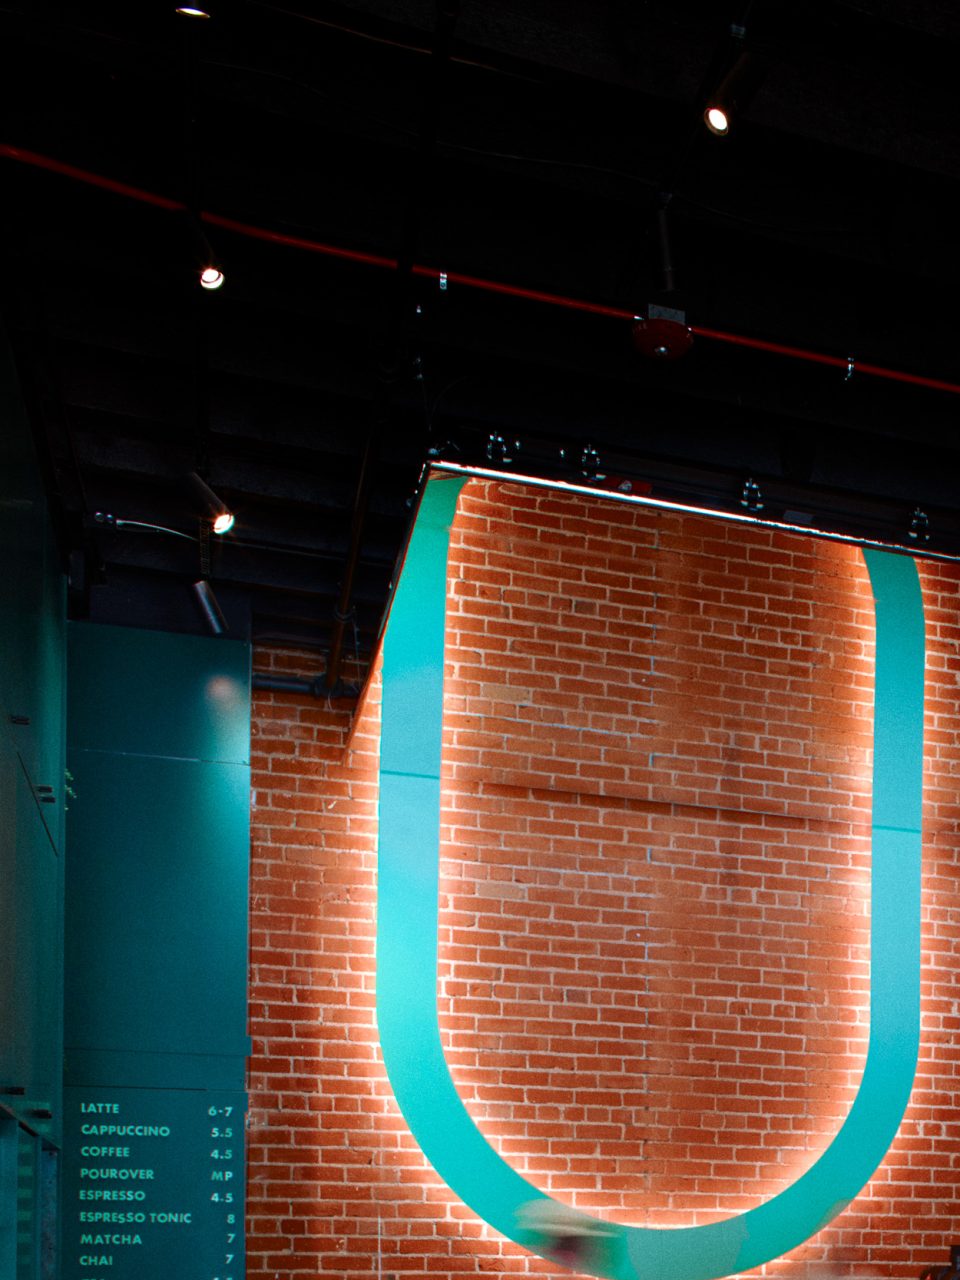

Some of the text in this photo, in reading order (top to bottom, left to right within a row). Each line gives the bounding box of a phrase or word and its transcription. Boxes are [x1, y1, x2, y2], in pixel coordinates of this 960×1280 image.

[81, 1103, 119, 1114] LATTE
[208, 1105, 233, 1117] 6-7
[81, 1124, 171, 1137] CAPPUCCINO
[211, 1127, 233, 1138] 5.5
[81, 1146, 129, 1157] COFFEE
[211, 1149, 232, 1160] 4.5
[81, 1168, 154, 1180] POUROVER
[211, 1171, 233, 1181] MP
[80, 1190, 146, 1201] ESPRESSO
[211, 1192, 233, 1203] 4.5
[80, 1211, 192, 1224] ESPRESSO TONIC
[227, 1213, 236, 1225] 8
[81, 1234, 142, 1245] MATCHA
[227, 1232, 236, 1244] 7
[79, 1255, 113, 1266] CHAI
[225, 1253, 235, 1264] 7
